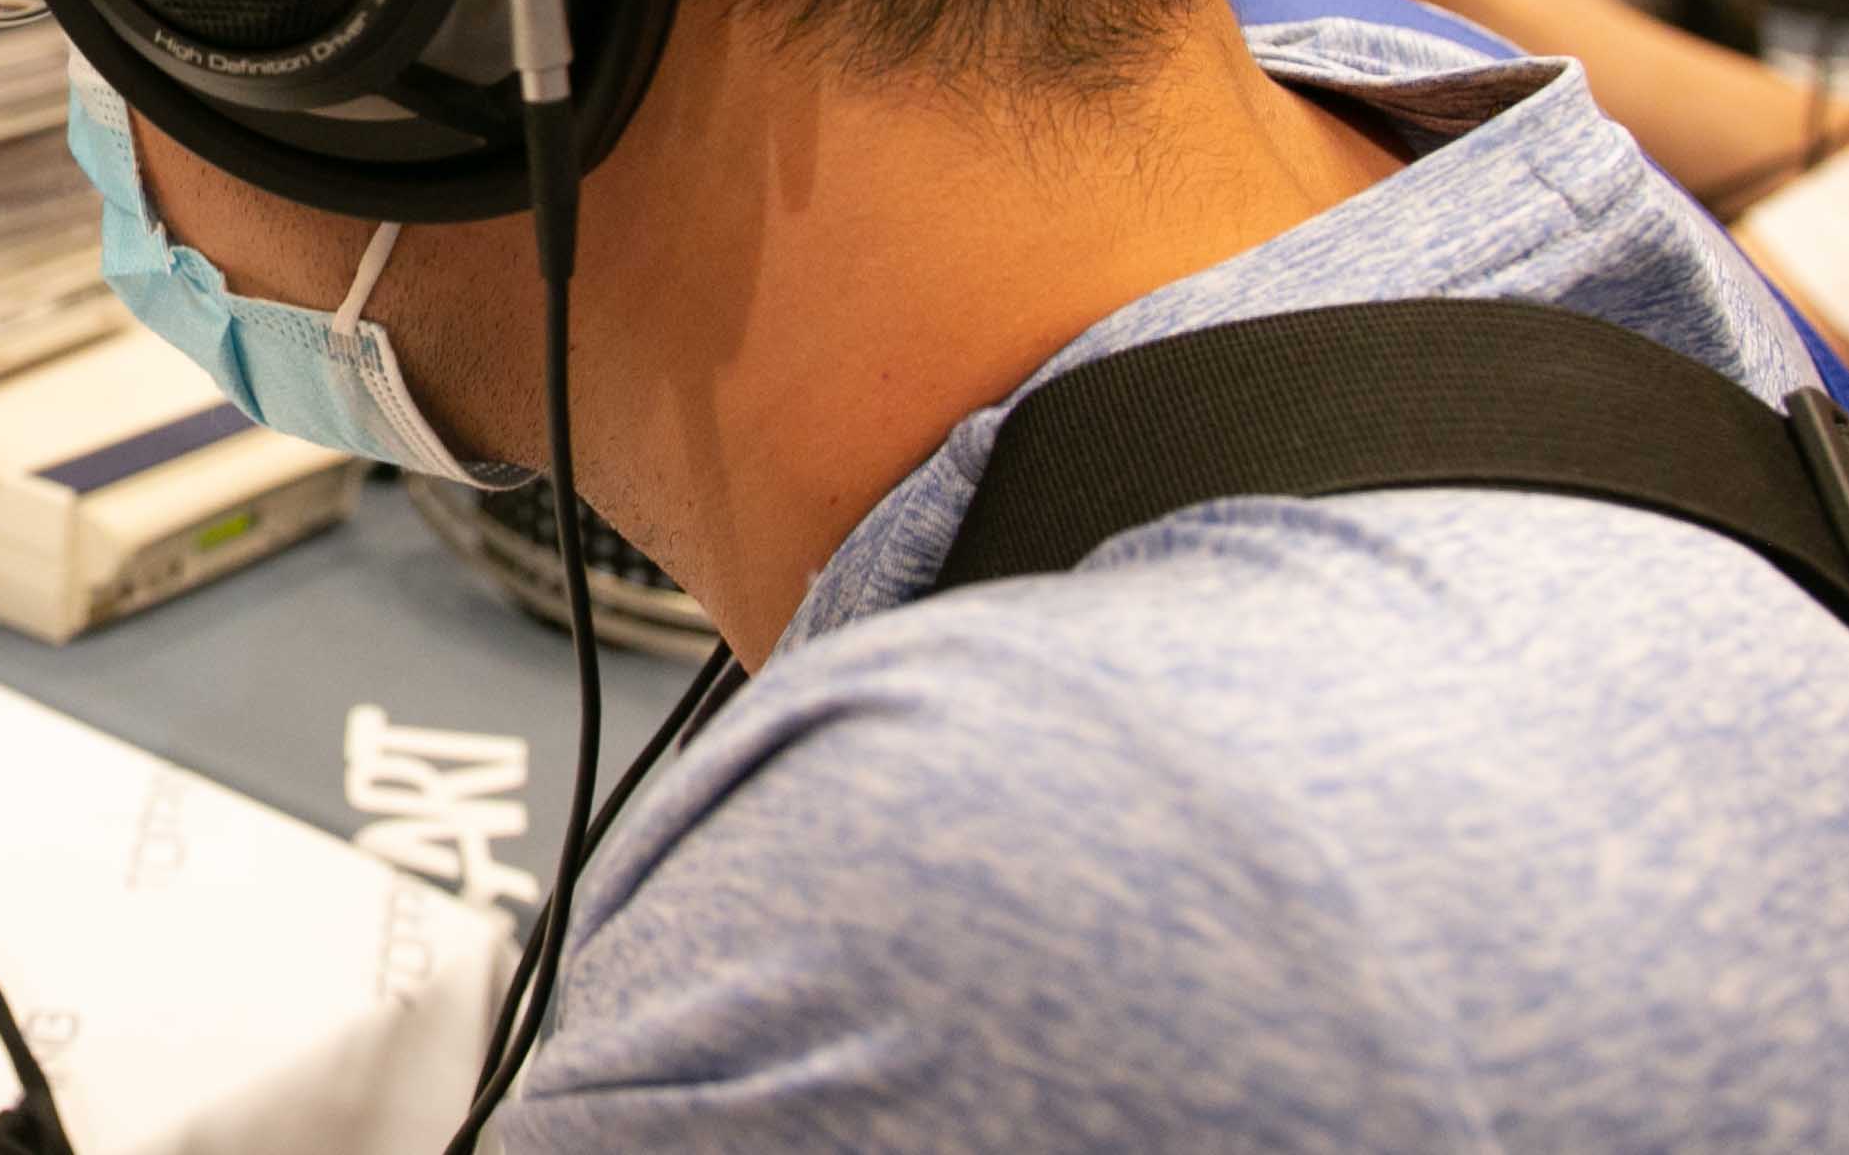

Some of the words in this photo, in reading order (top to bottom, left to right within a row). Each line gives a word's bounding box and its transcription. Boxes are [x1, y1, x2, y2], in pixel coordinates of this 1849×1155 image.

[154, 28, 202, 64] High
[208, 53, 311, 76] Definition
[311, 10, 368, 62] Driver
